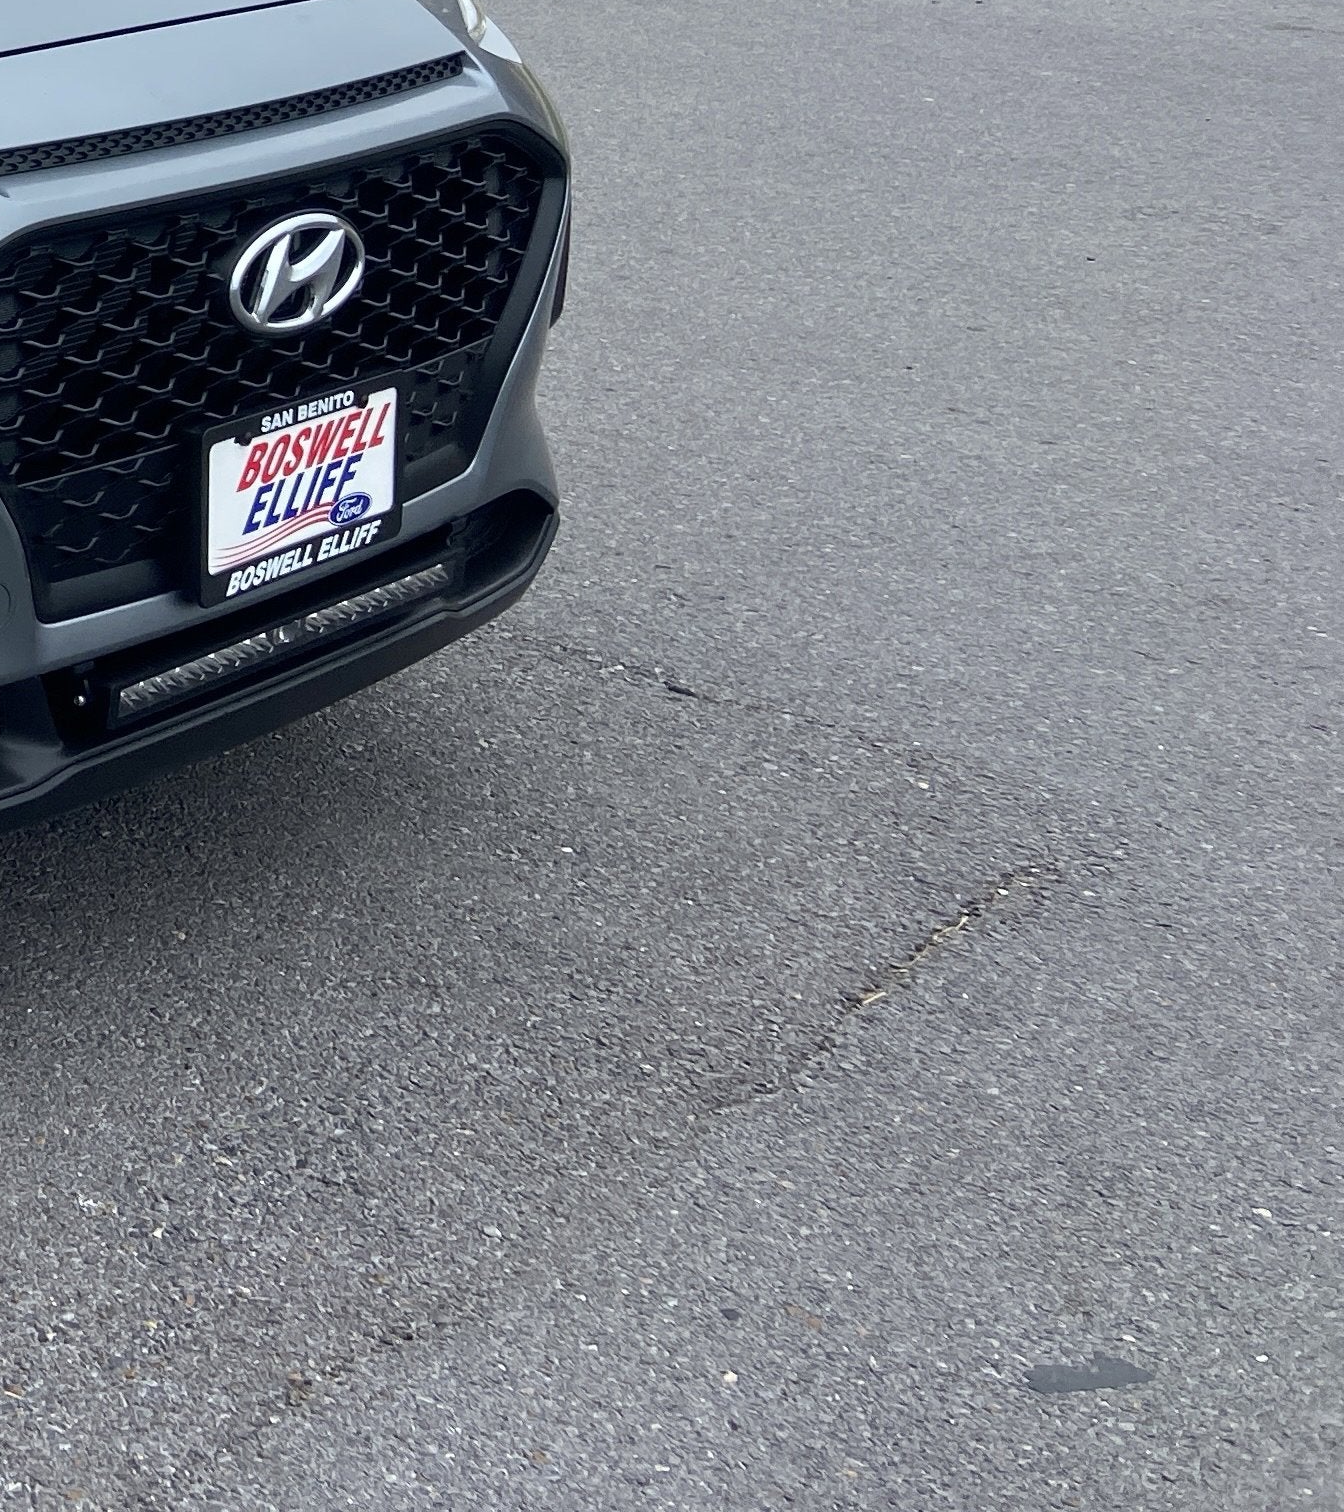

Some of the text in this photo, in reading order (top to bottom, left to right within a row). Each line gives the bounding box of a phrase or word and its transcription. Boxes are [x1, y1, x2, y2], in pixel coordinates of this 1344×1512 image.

[236, 402, 392, 493] BOSWELL
[260, 390, 355, 433] SAN BENITO
[242, 452, 364, 536] ELLIFF
[334, 496, 364, 522] Ford
[225, 519, 382, 598] BOSWELL ELLIFF
